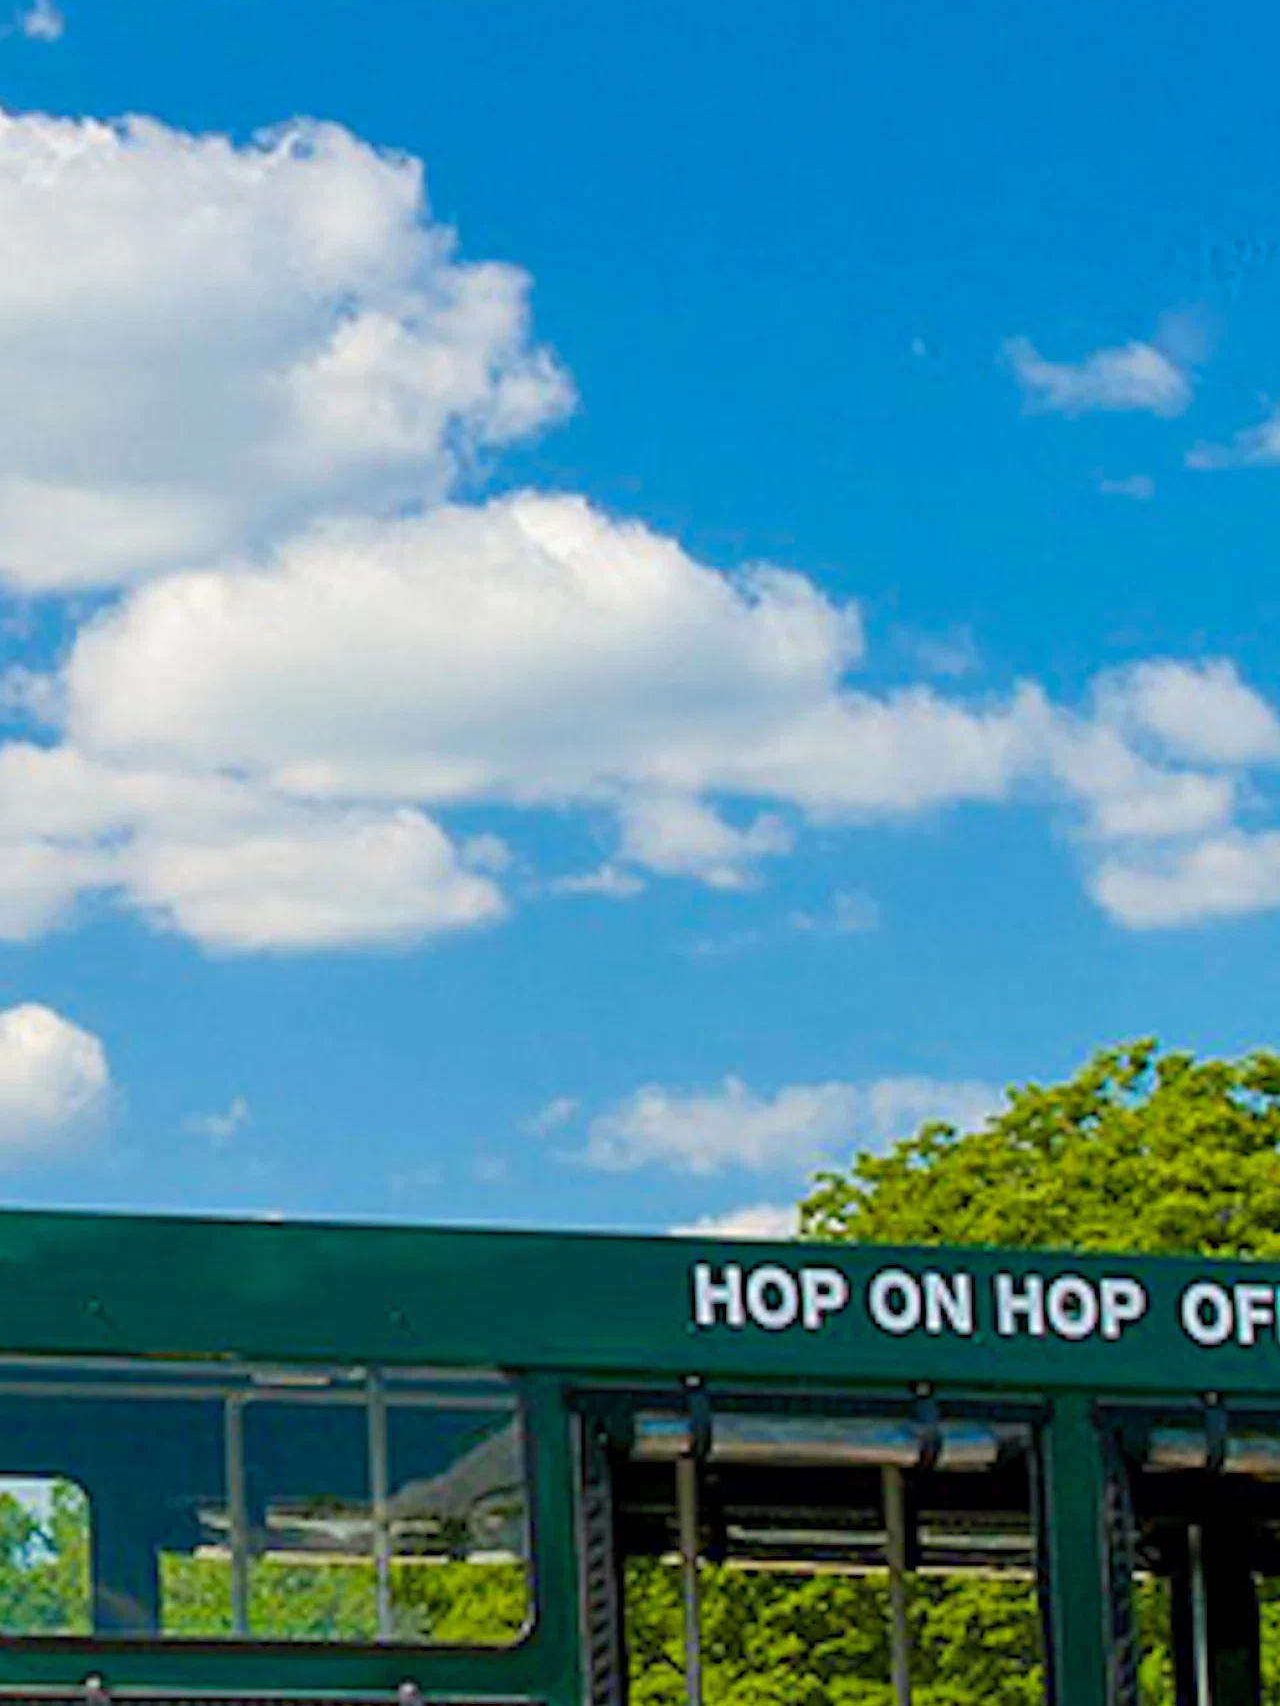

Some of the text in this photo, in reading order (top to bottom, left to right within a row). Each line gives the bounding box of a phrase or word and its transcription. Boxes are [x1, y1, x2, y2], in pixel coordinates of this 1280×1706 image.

[693, 1262, 1280, 1346] HOP ON HOP OF
